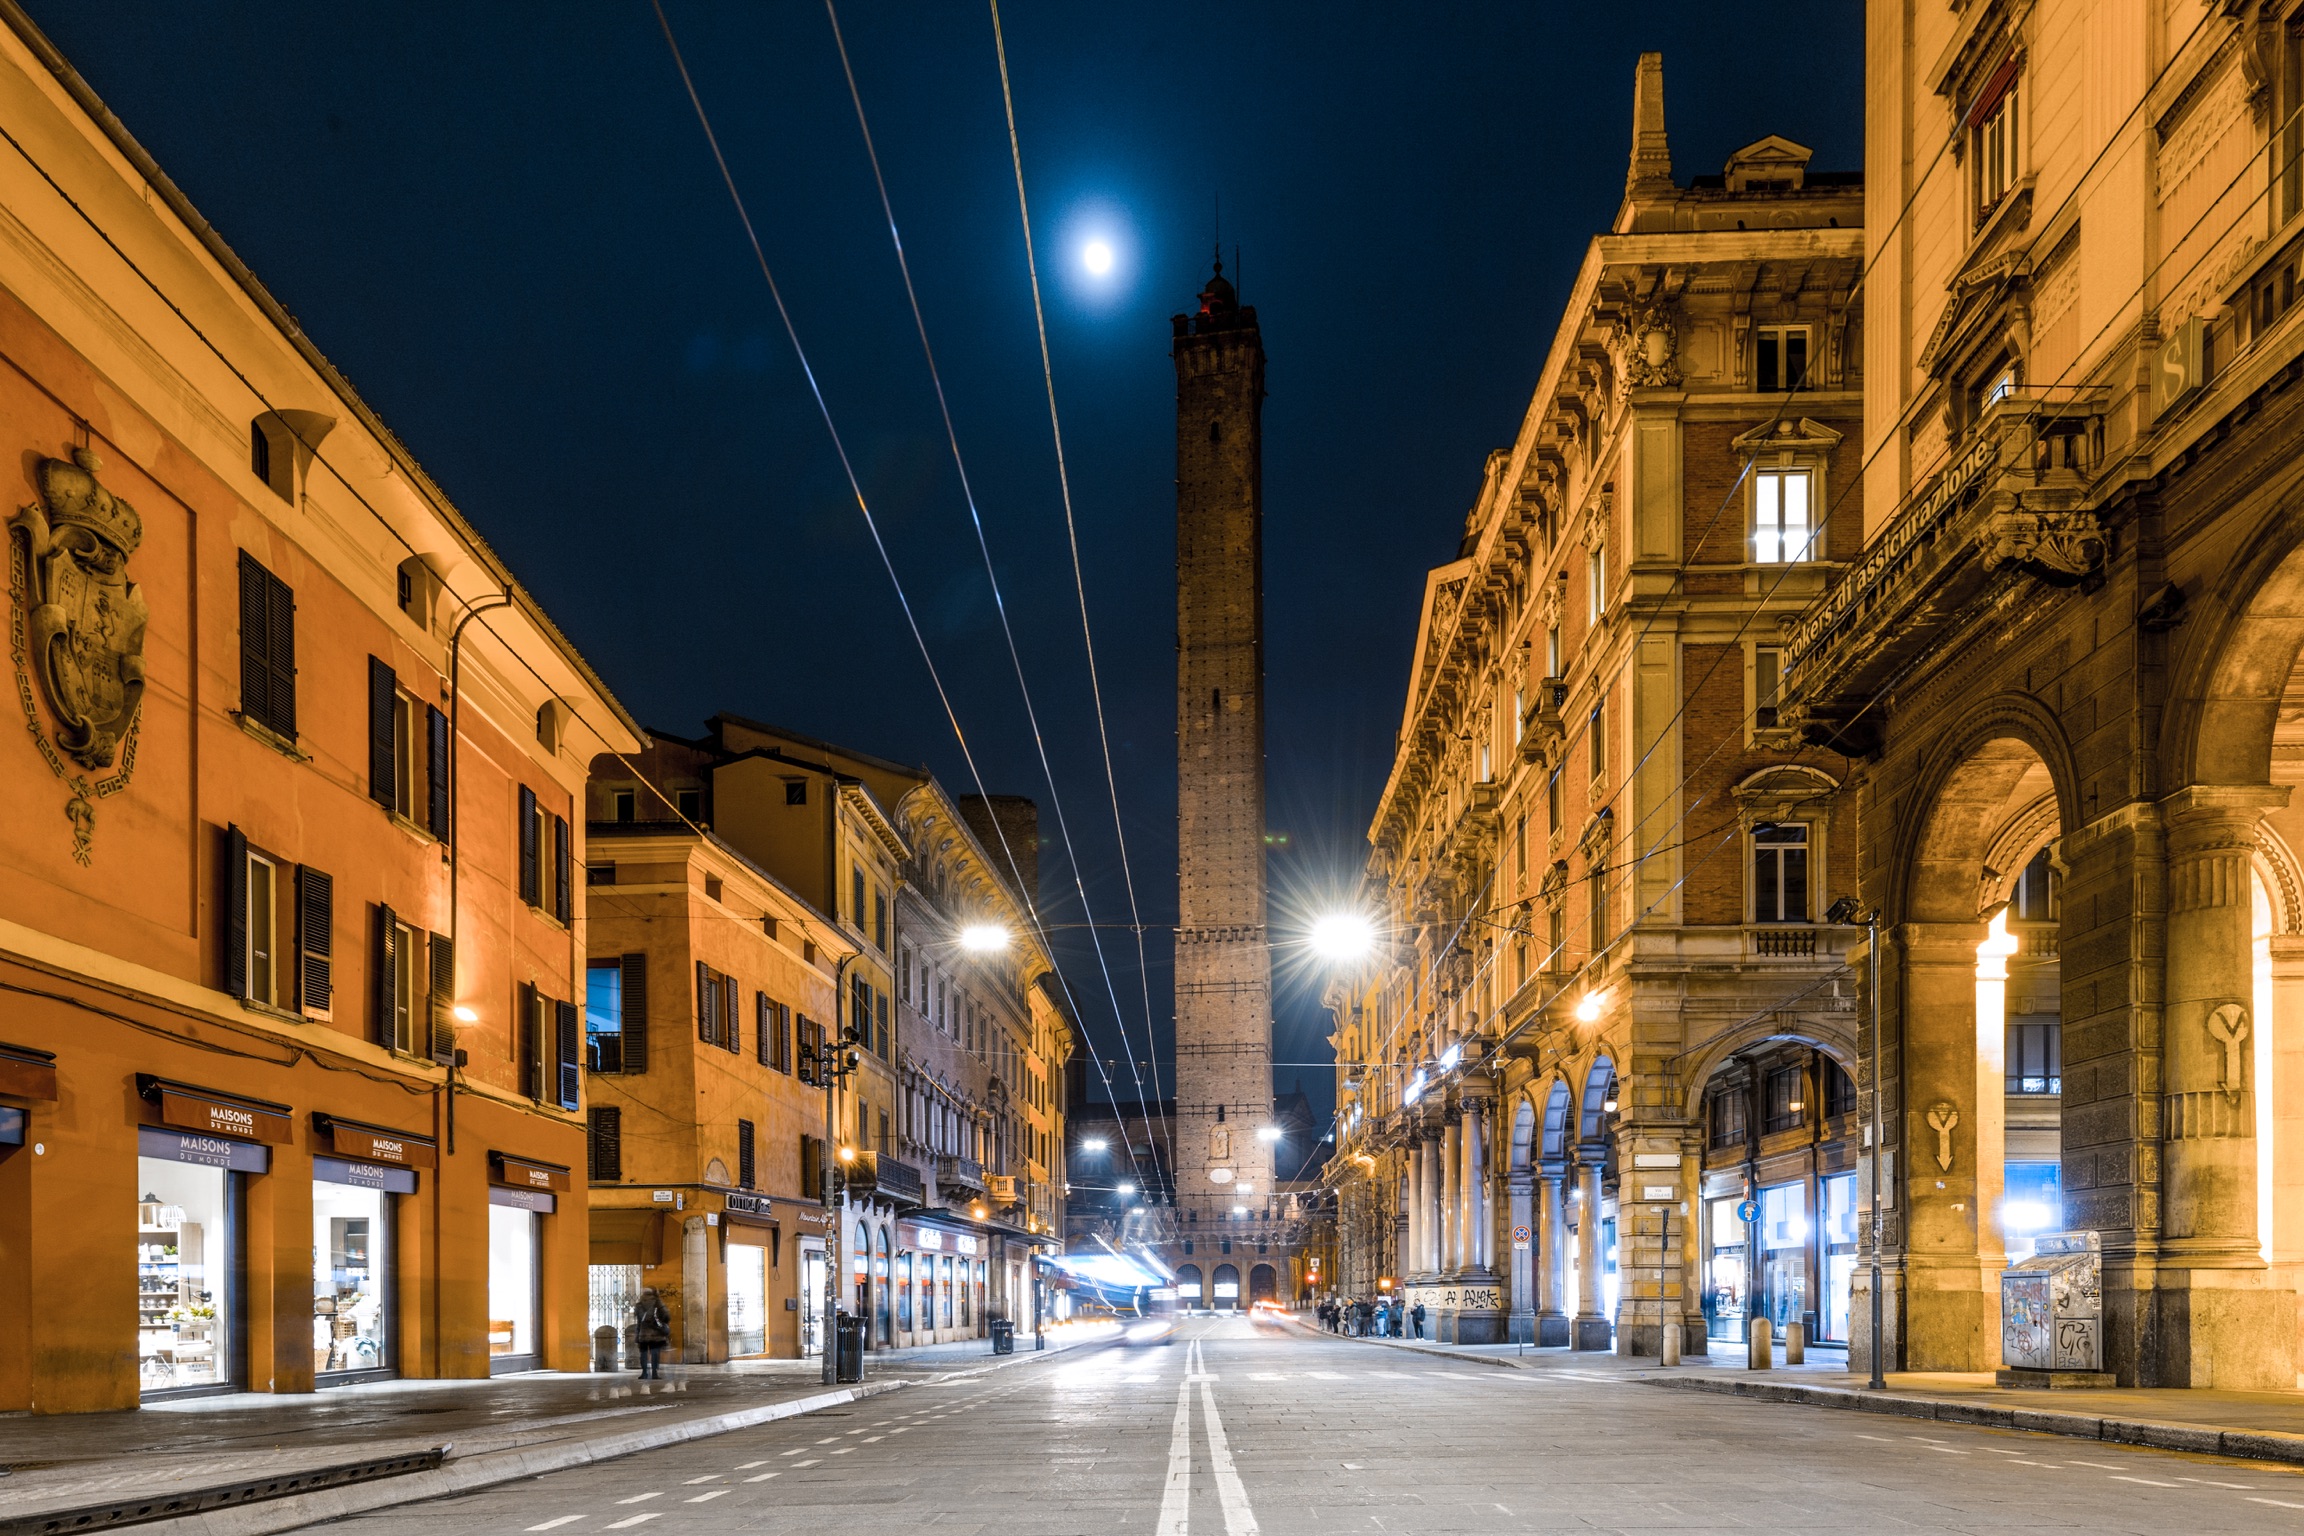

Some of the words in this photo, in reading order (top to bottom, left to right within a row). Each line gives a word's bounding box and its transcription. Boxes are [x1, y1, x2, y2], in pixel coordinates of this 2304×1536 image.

[1782, 605, 1832, 667] brokers
[1836, 575, 1852, 611] di
[1857, 441, 1988, 593] assicurazione
[210, 1107, 253, 1125] MAISONS
[211, 1121, 221, 1129] DU
[226, 1125, 253, 1135] MONDE
[180, 1136, 231, 1155] MAISONS
[372, 1139, 403, 1153] MAISONS
[180, 1152, 192, 1161] DU
[199, 1156, 231, 1166] MONDE
[348, 1164, 384, 1179] MAISONS
[529, 1170, 549, 1181] MAISONS
[361, 1179, 384, 1188] MONDE
[511, 1191, 534, 1202] MAISONS
[731, 1195, 756, 1212] OTTICA
